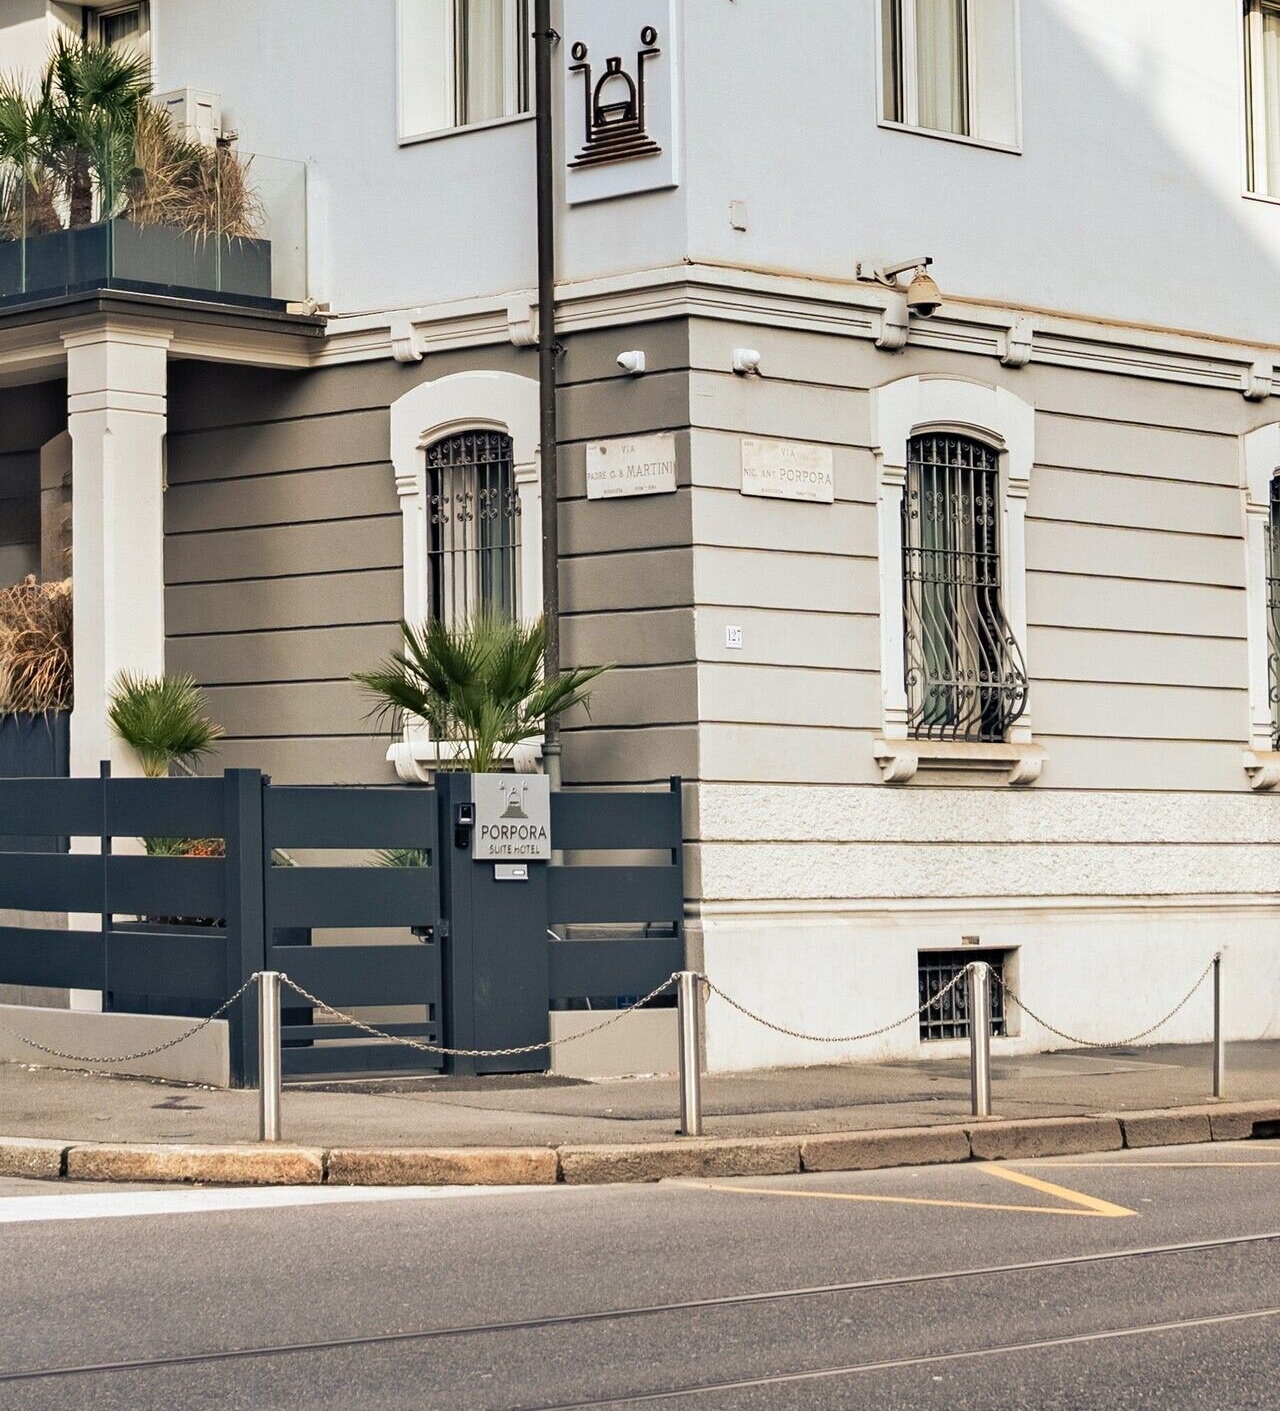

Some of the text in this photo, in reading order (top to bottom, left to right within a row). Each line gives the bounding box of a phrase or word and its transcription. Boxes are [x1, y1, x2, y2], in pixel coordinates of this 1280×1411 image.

[622, 445, 635, 454] VIA
[780, 447, 795, 458] VIA
[626, 461, 673, 479] MARTINI
[780, 468, 832, 486] PORPORA
[727, 628, 741, 642] 127
[481, 824, 548, 841] PORPORA
[489, 844, 540, 855] SUITE HOTEL
